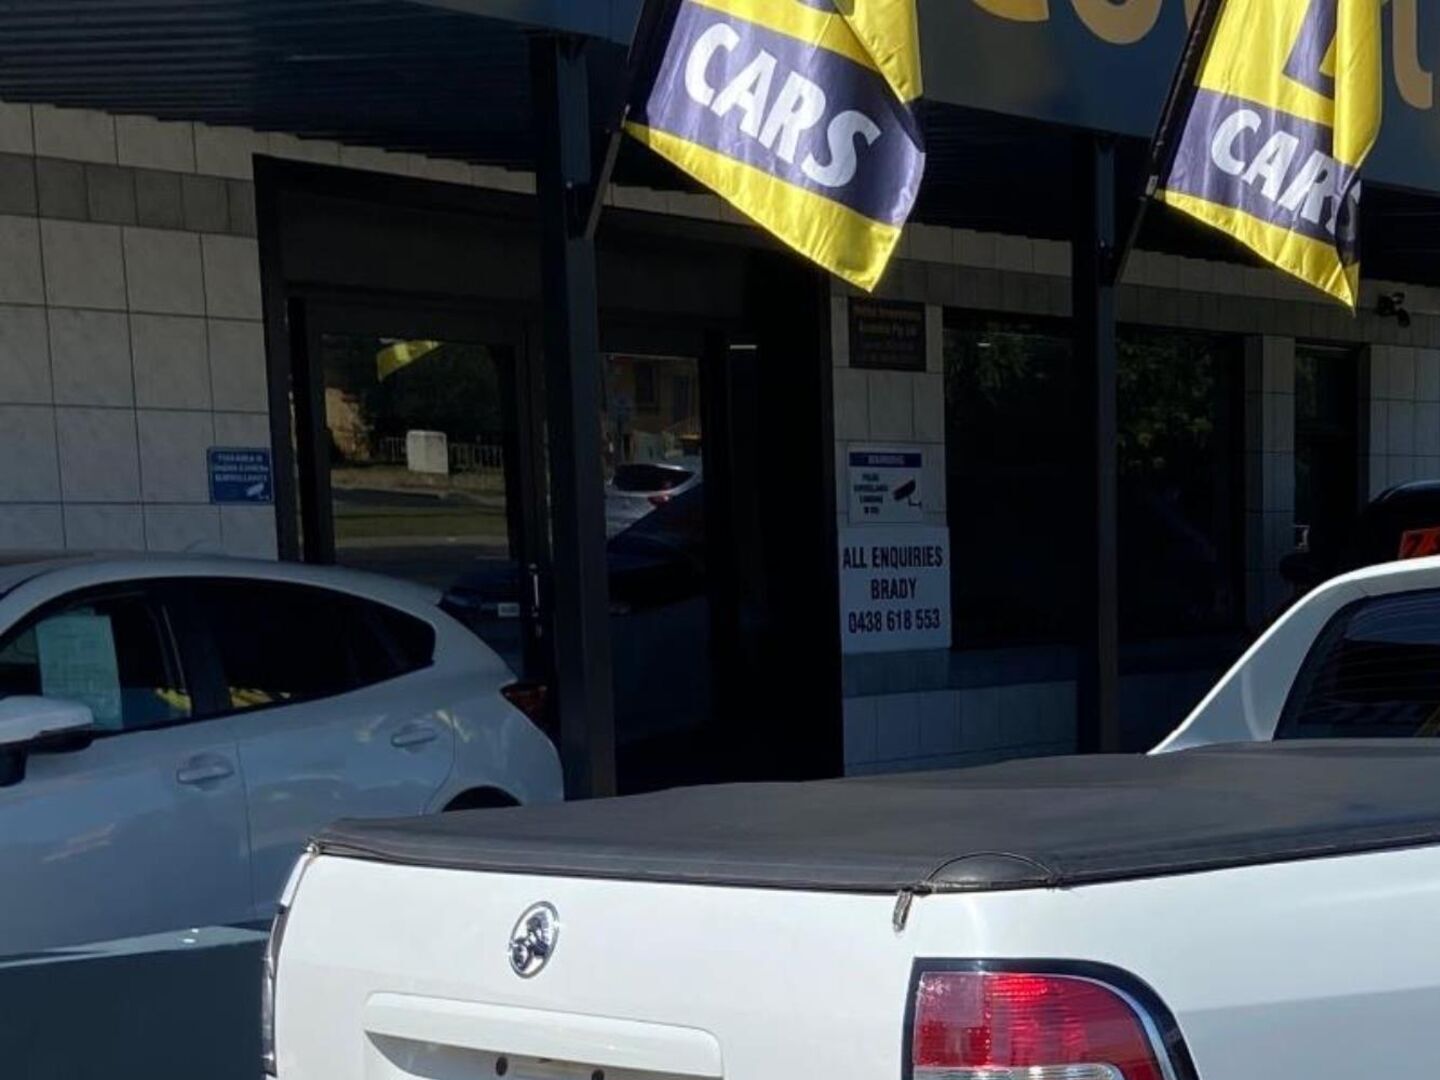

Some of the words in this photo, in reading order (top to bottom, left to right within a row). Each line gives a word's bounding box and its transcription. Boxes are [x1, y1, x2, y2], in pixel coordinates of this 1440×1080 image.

[685, 23, 881, 187] CARS
[843, 547, 868, 569] ALL
[872, 546, 943, 569] ENQUIRIES
[871, 578, 917, 600] BRADY
[848, 610, 882, 634] 0438
[886, 609, 912, 632] 618
[915, 607, 941, 630] 553
